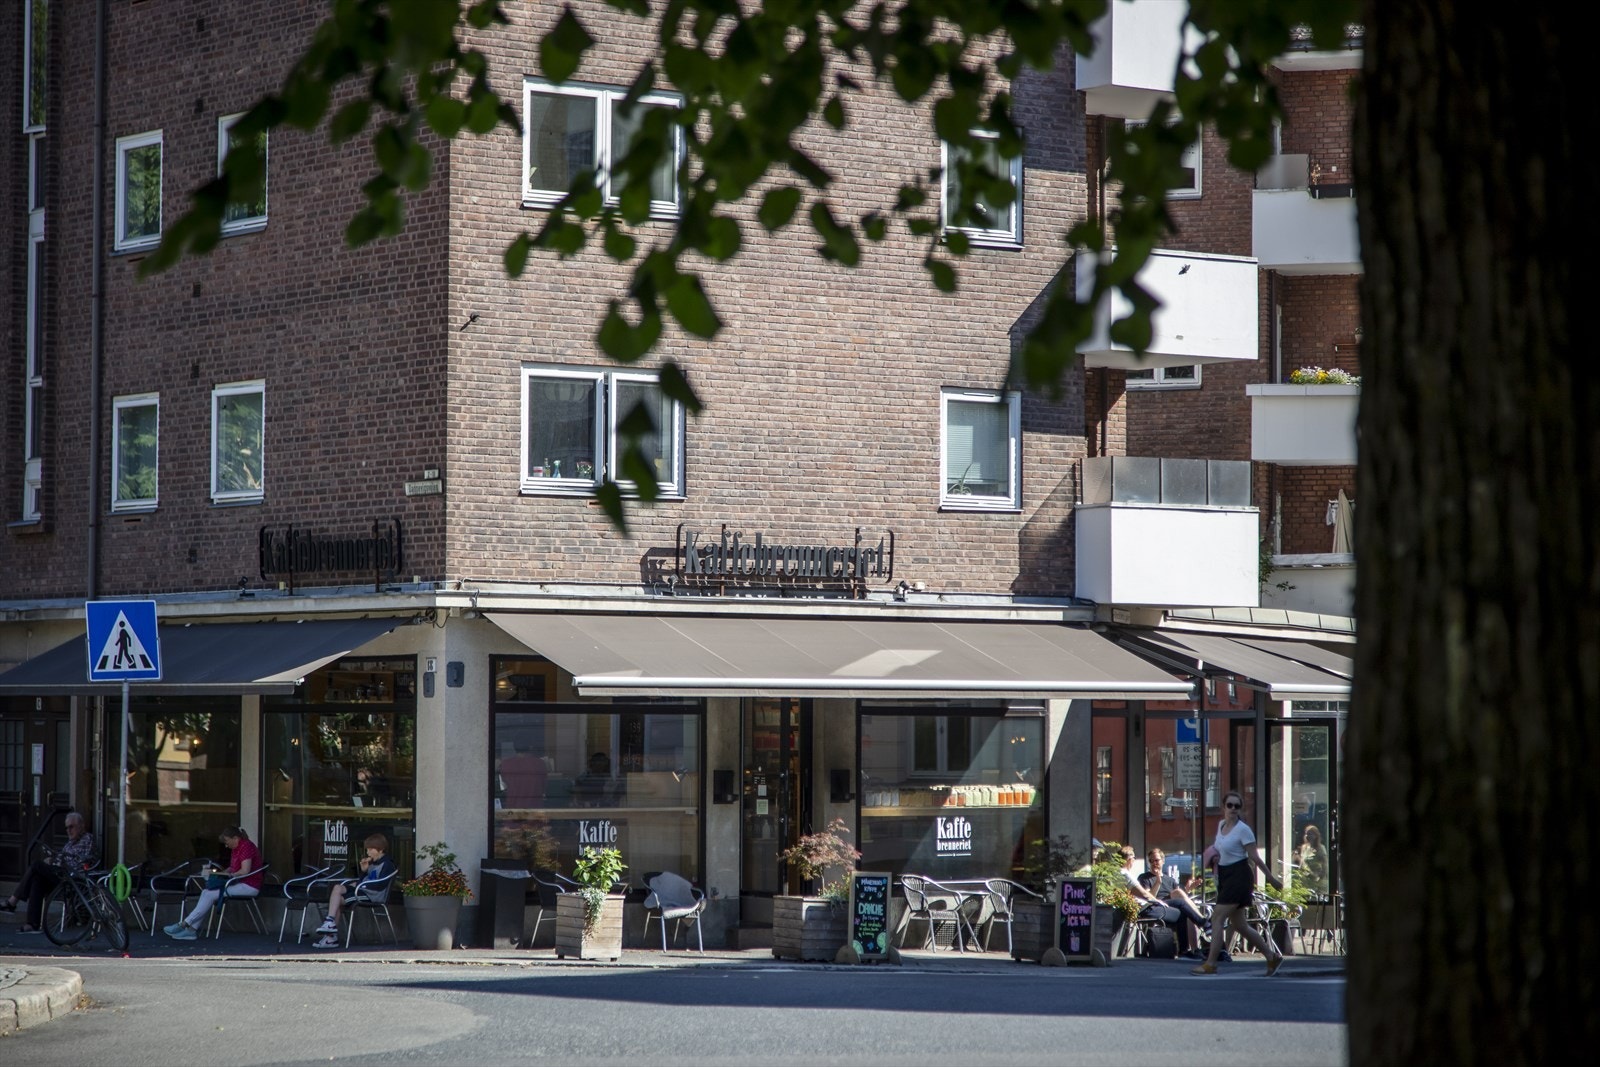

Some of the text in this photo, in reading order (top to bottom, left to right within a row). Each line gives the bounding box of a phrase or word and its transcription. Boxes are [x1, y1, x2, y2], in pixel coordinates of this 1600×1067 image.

[264, 525, 397, 574] Kaffebrenneriet
[684, 530, 888, 579] Kaffebrenneriet
[324, 820, 348, 842] Kaffe
[579, 820, 618, 843] Kaffe
[937, 816, 972, 839] Kaffe
[937, 839, 972, 851] brenneriet
